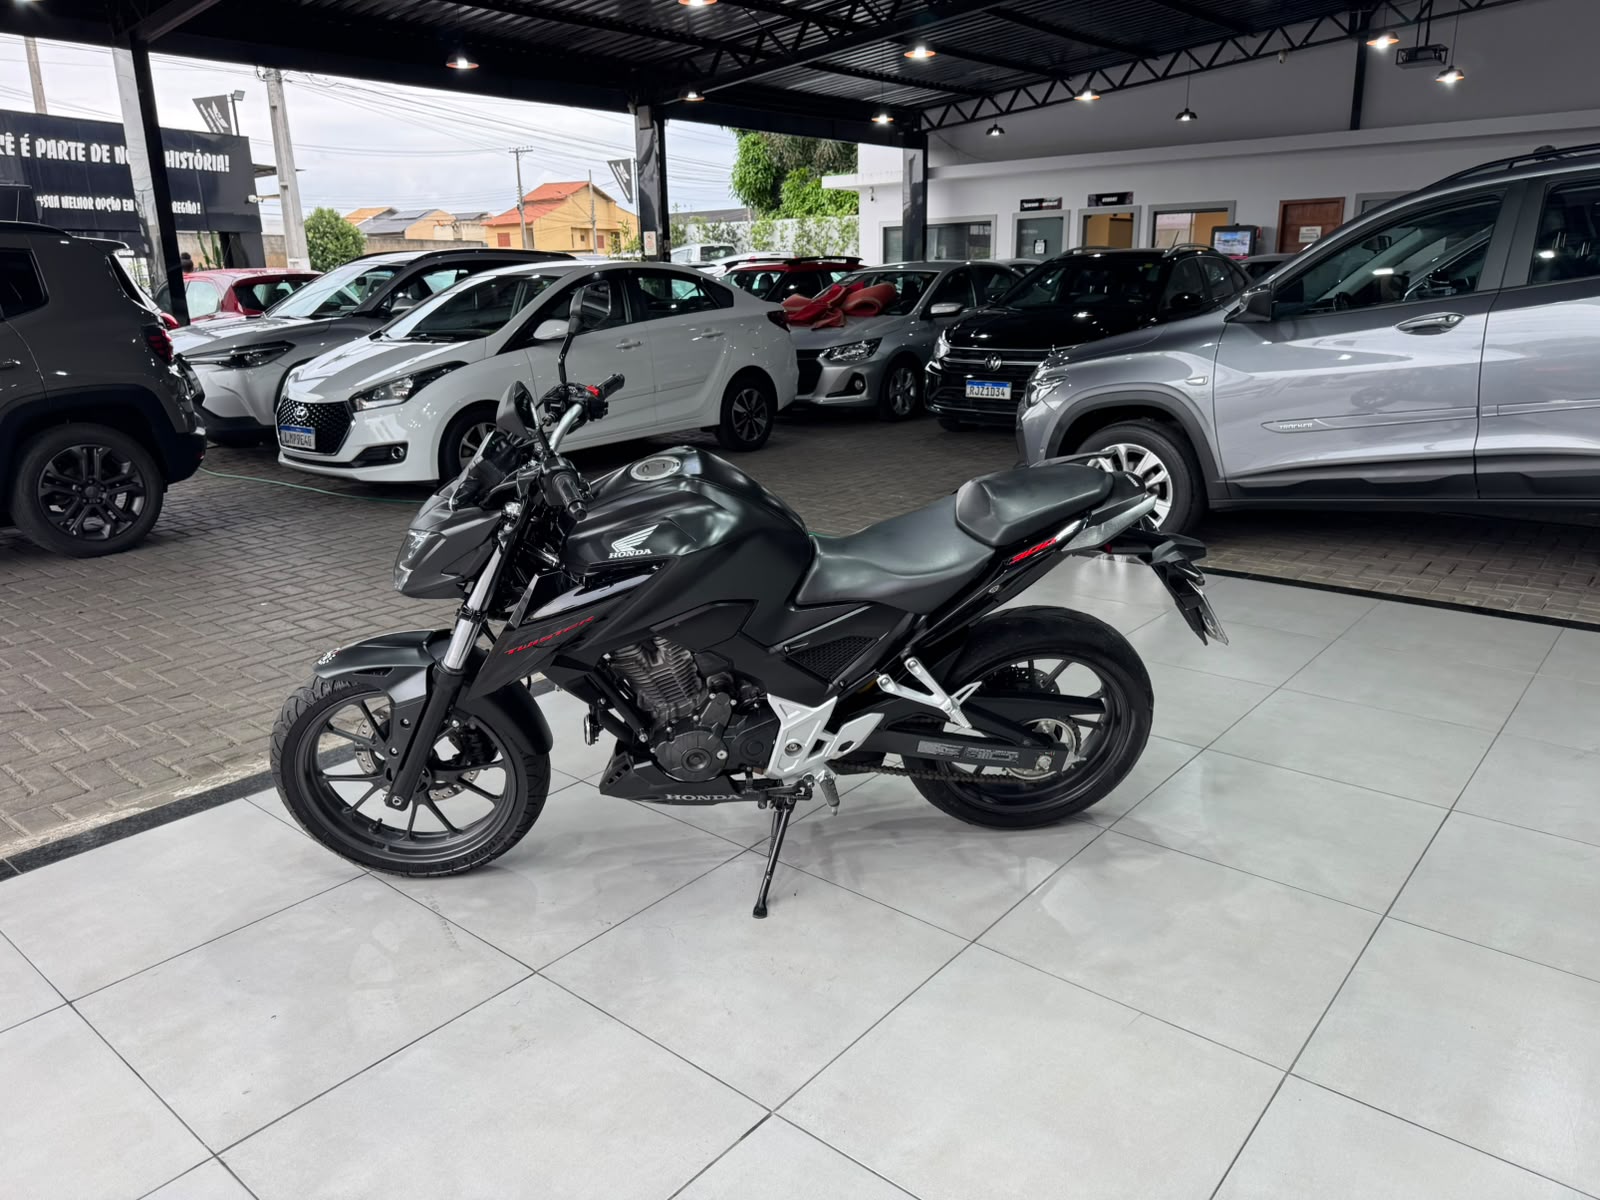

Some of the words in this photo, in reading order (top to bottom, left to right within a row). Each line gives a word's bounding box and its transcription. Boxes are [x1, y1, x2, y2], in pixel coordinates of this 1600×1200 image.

[20, 133, 31, 157] É
[35, 138, 86, 162] PARTE
[90, 143, 111, 163] DE
[164, 149, 230, 172] HISTÓRIA!
[61, 196, 94, 210] MELHOR
[95, 196, 121, 213] OPÇÃO
[122, 199, 135, 212] EM
[969, 386, 1006, 398] RJZ1D34
[608, 549, 653, 559] HONDA
[664, 793, 744, 801] HONDA
